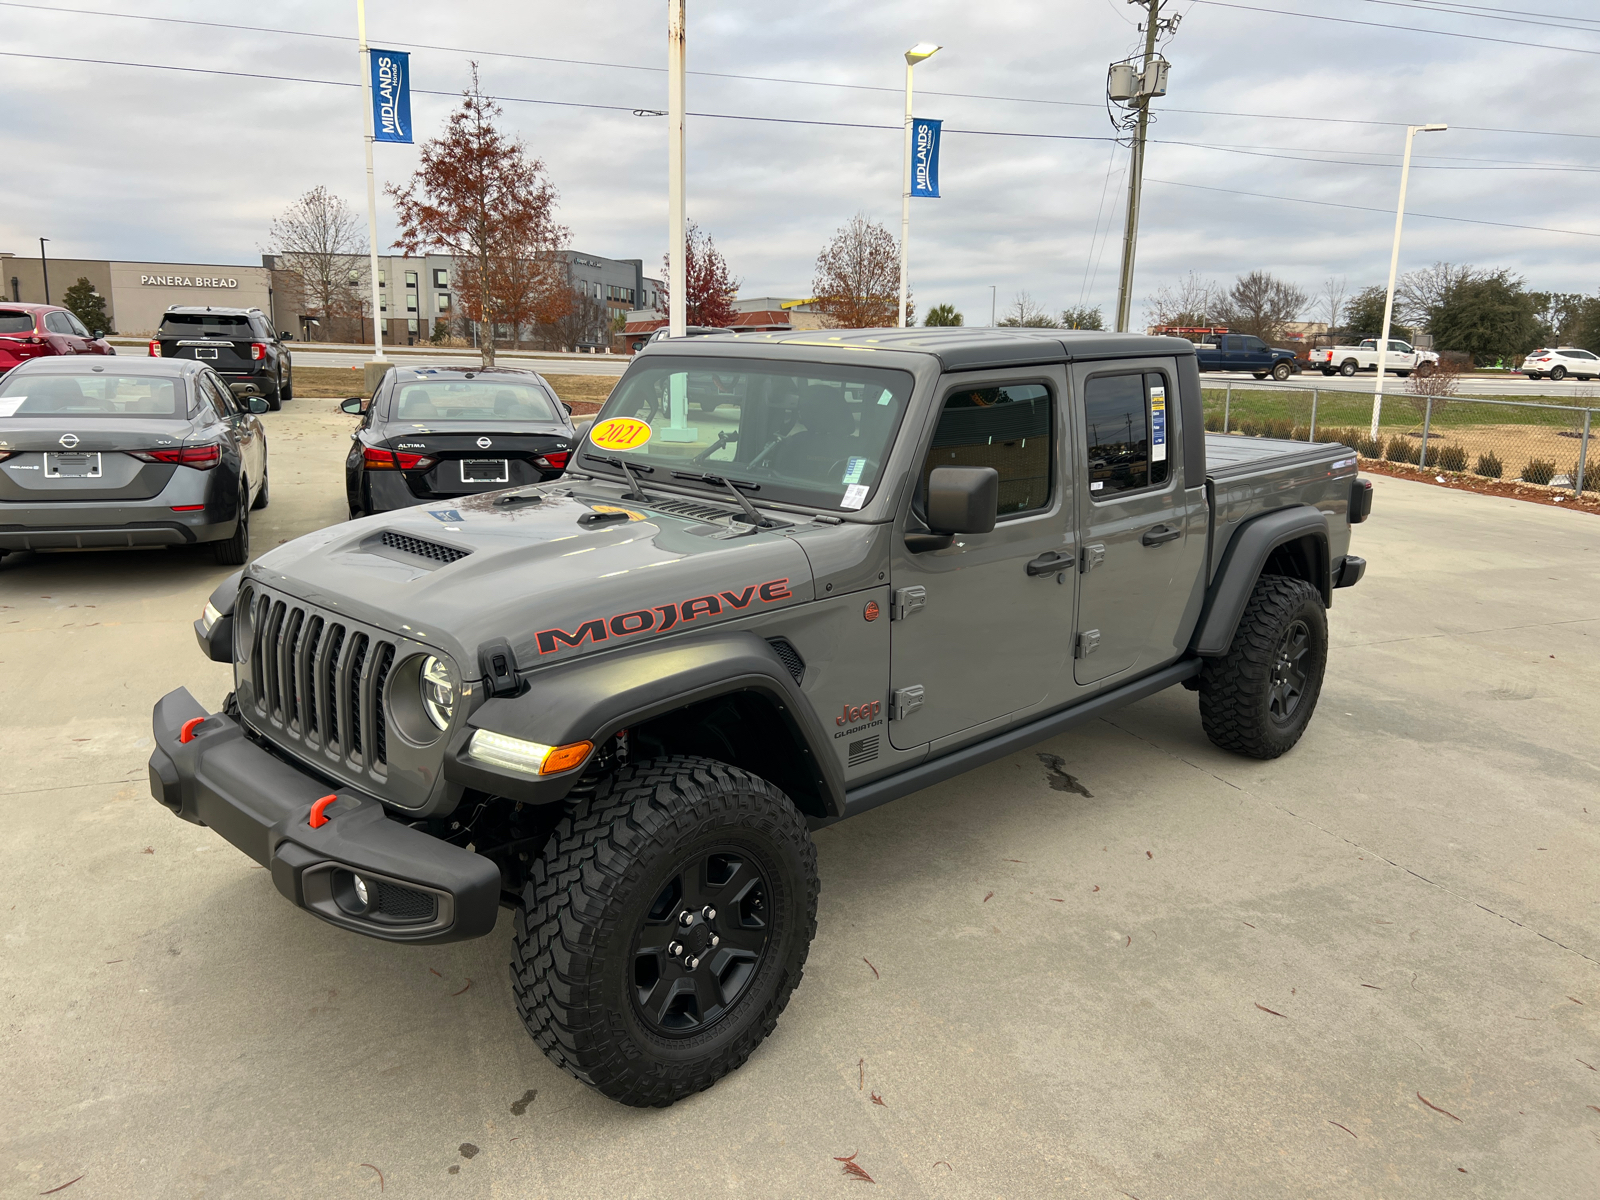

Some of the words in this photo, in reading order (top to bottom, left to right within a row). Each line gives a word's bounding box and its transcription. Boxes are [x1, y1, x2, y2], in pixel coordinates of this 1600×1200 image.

[379, 57, 394, 133] MIDLANDS
[917, 124, 928, 190] MIDLANDS
[141, 275, 192, 287] PANERA
[195, 277, 238, 288] BREAD
[596, 423, 644, 444] 2021
[534, 577, 792, 655] MOJAVE
[836, 700, 881, 727] Jeep
[834, 719, 883, 739] GLADIATOR
